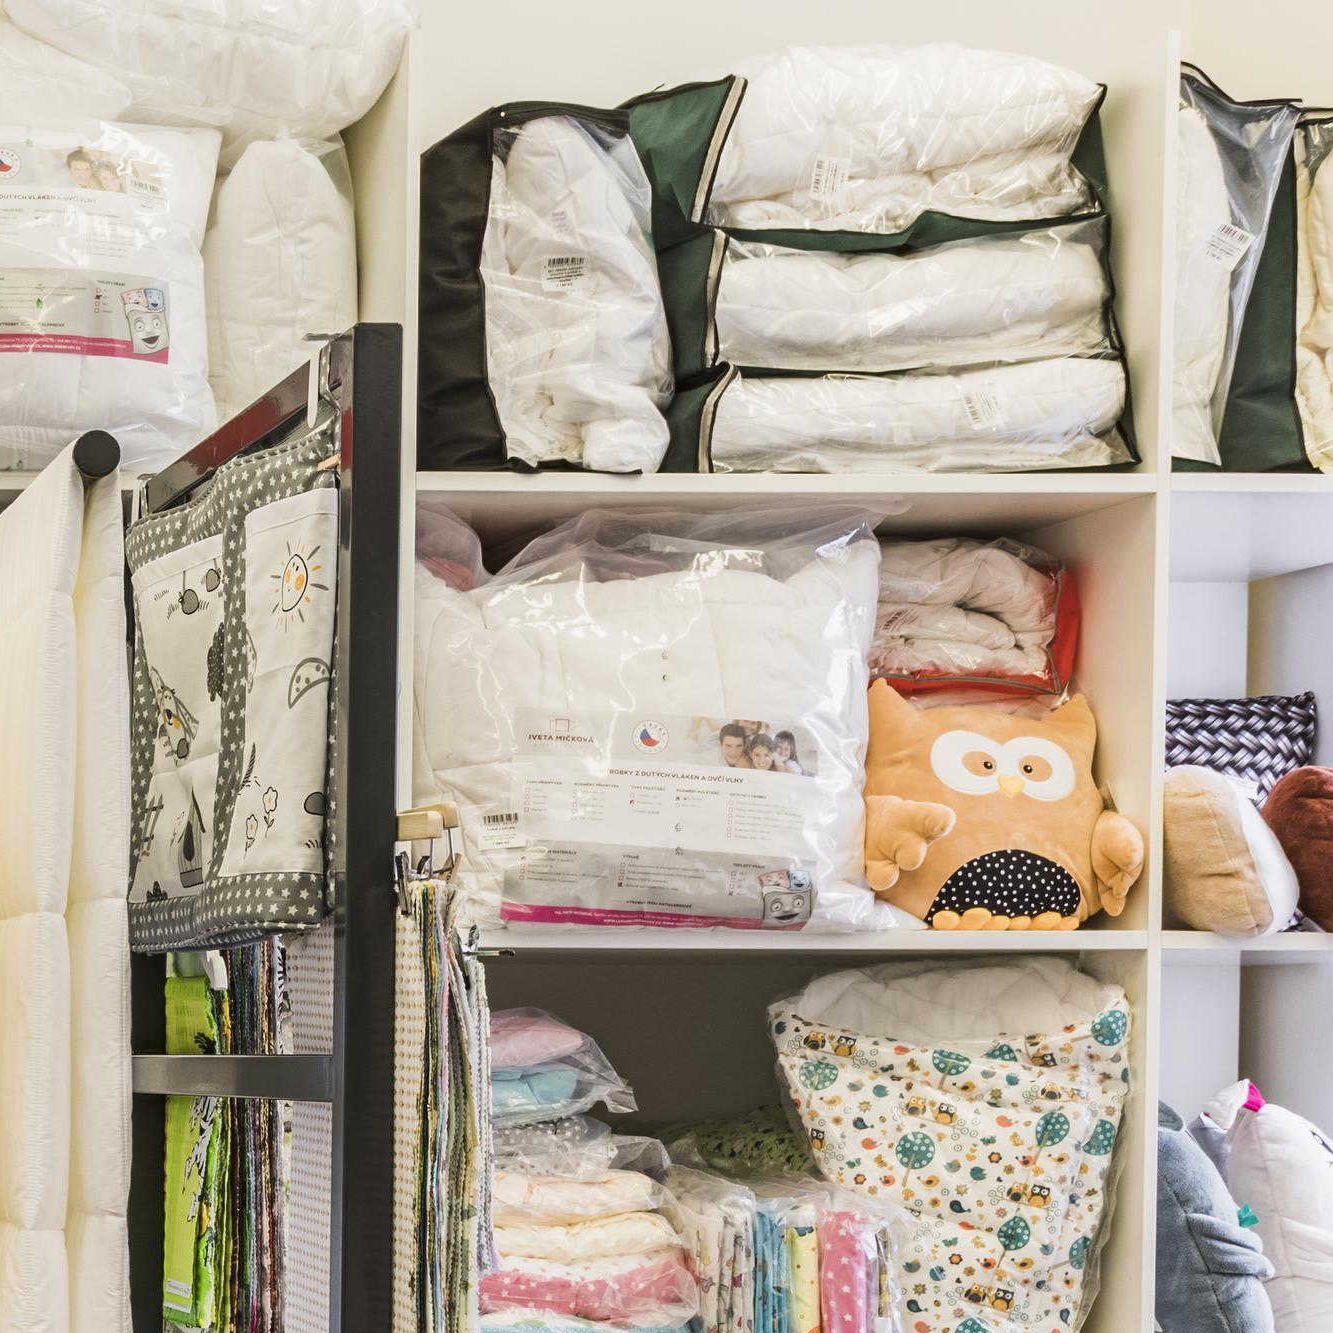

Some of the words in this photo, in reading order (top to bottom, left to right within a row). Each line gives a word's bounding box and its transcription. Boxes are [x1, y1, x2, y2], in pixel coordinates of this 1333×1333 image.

[555, 733, 594, 743] MIČKOVÁ
[641, 769, 671, 778] DUTÝCH
[672, 771, 700, 780] VLÁKEN
[708, 774, 725, 782] OVČÍ
